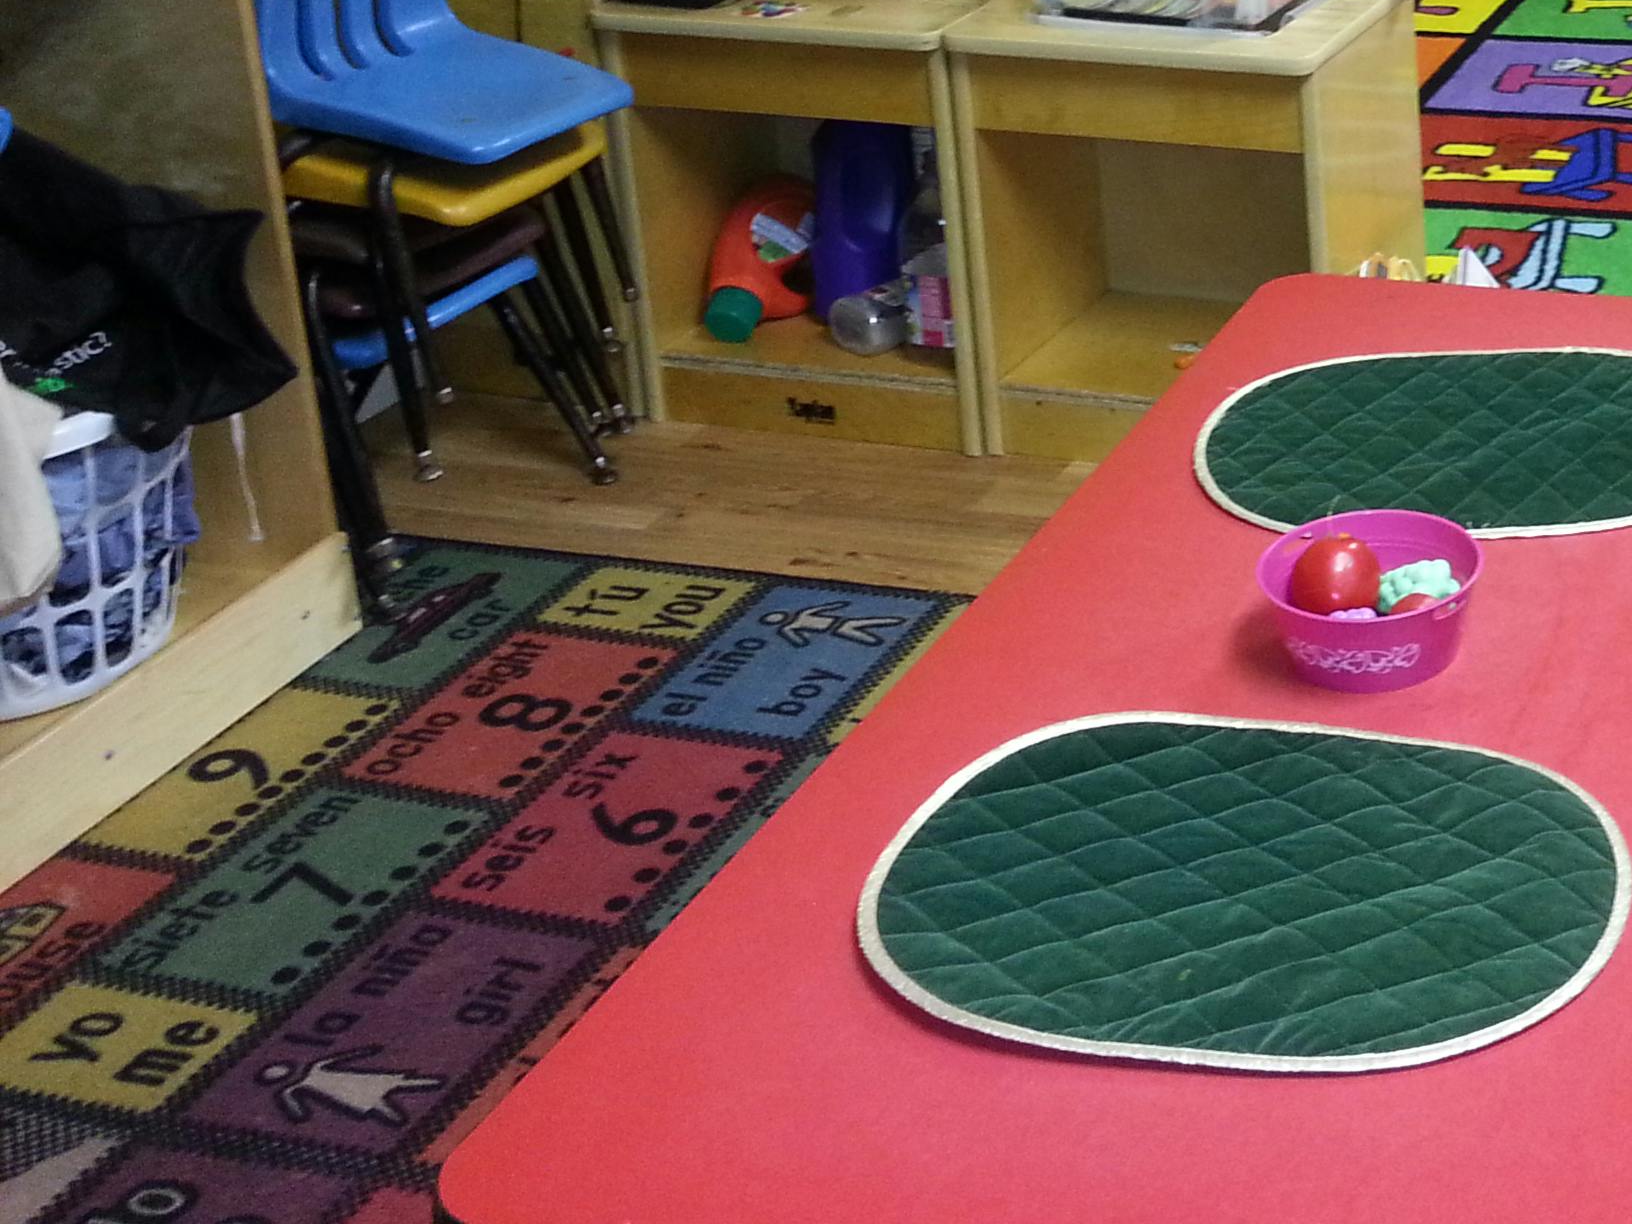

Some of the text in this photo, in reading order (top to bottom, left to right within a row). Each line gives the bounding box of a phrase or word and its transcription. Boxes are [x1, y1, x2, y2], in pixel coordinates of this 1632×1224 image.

[448, 597, 512, 641] car
[639, 583, 726, 632] you
[661, 636, 768, 717] el niño
[755, 667, 846, 717] boy
[366, 638, 549, 776] ocho eight
[478, 693, 573, 732] 8
[187, 747, 271, 790] 9
[461, 753, 639, 892] seis six
[591, 801, 679, 846] 6
[120, 794, 361, 978] siete seven
[250, 860, 353, 905] 7
[454, 956, 546, 1026] girl
[28, 1010, 125, 1063] yo
[113, 1019, 221, 1087] me
